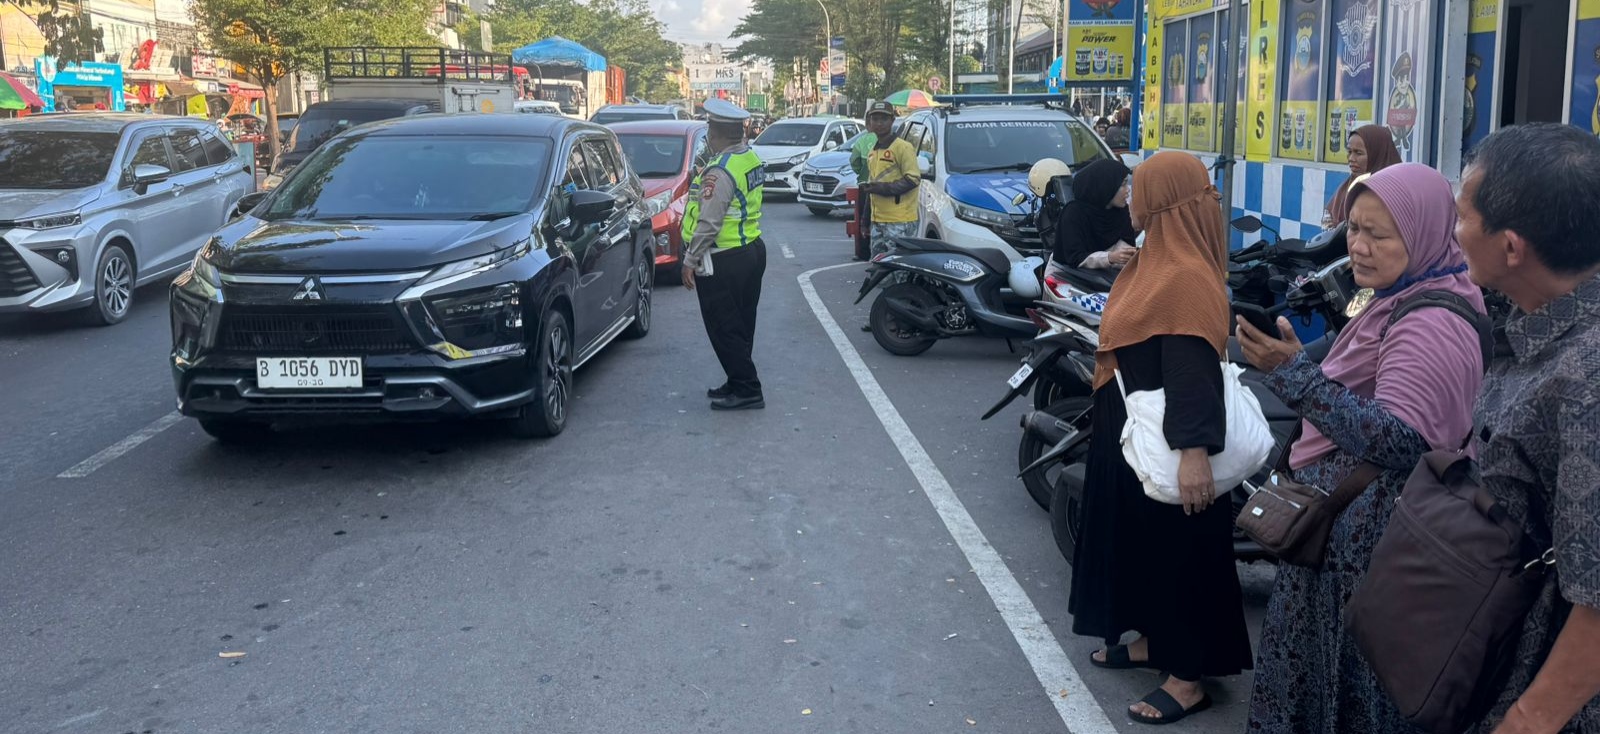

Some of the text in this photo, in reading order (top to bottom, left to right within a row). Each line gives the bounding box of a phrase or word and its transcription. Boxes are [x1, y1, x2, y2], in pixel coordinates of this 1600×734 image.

[1001, 121, 1057, 129] DERMAGA
[1165, 124, 1183, 137] POWER
[260, 359, 360, 377] B 1056 DYD
